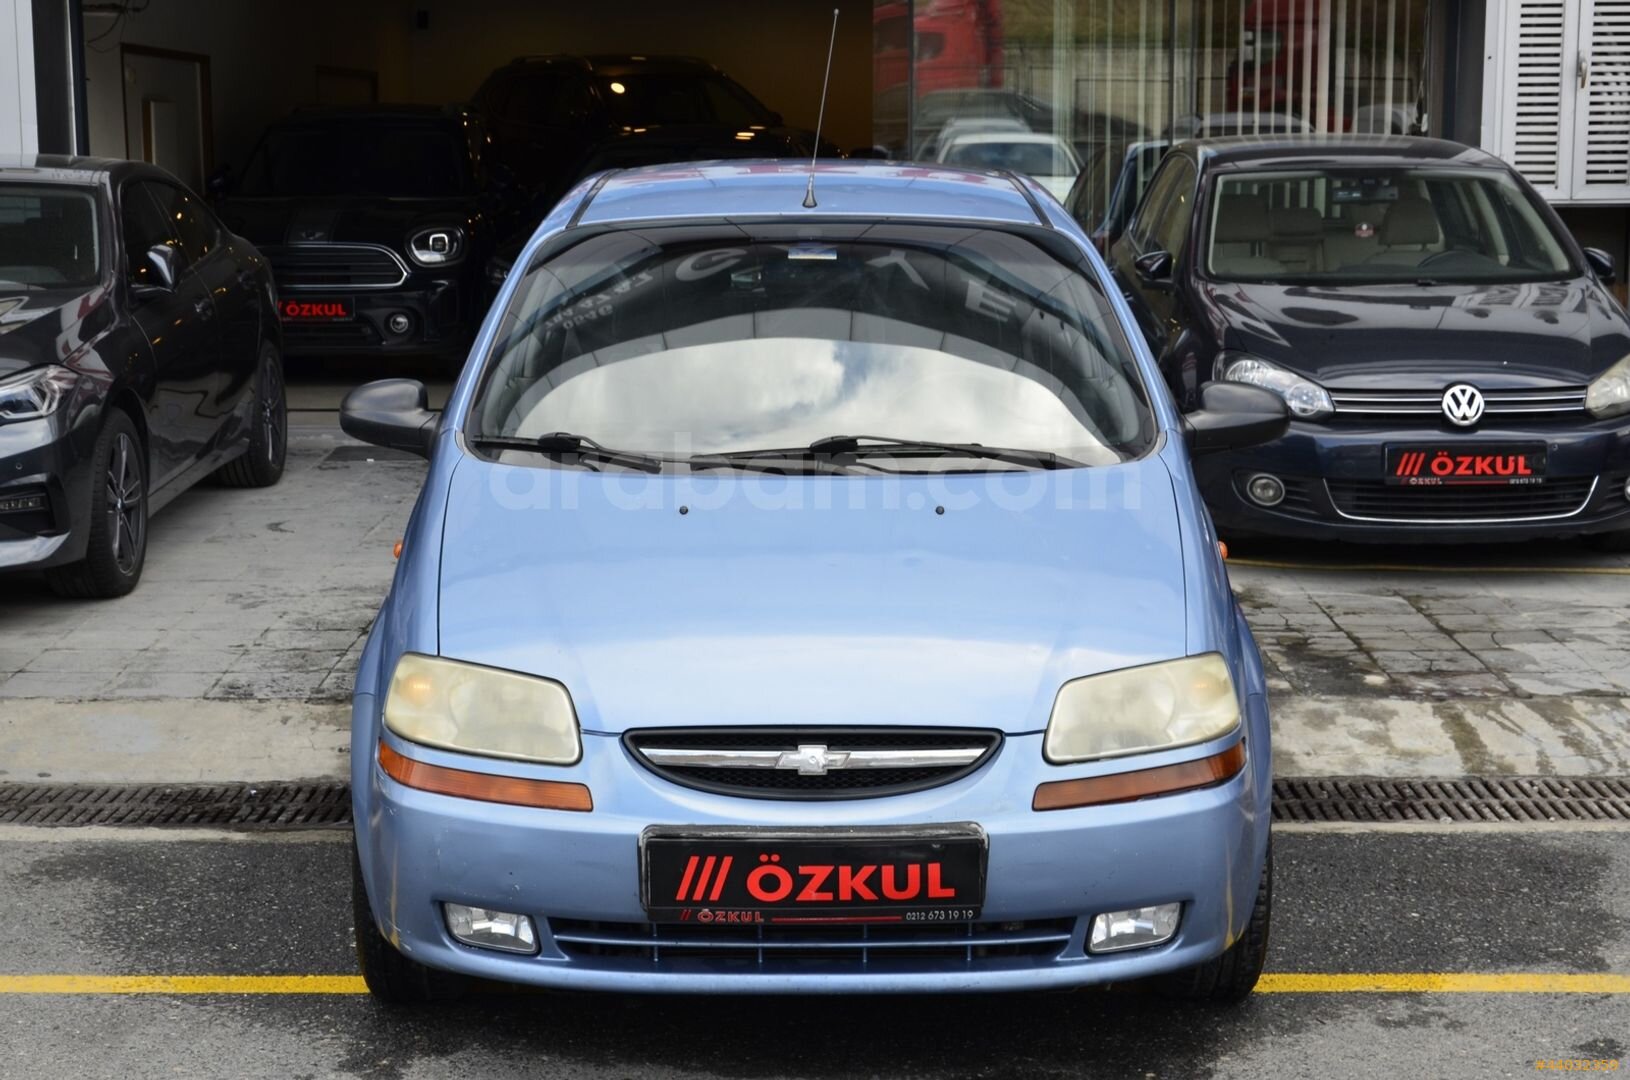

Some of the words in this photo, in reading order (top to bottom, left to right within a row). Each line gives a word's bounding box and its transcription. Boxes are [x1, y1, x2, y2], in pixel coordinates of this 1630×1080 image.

[286, 299, 346, 317] ÖZKUL
[1442, 385, 1485, 426] VW
[1431, 451, 1532, 476] ÖZKUL
[746, 854, 956, 902] ÖZKUL
[697, 908, 764, 923] ÖZKUL
[905, 912, 926, 921] 0212
[928, 910, 945, 920] 673
[948, 909, 960, 920] 19
[962, 909, 974, 920] 19
